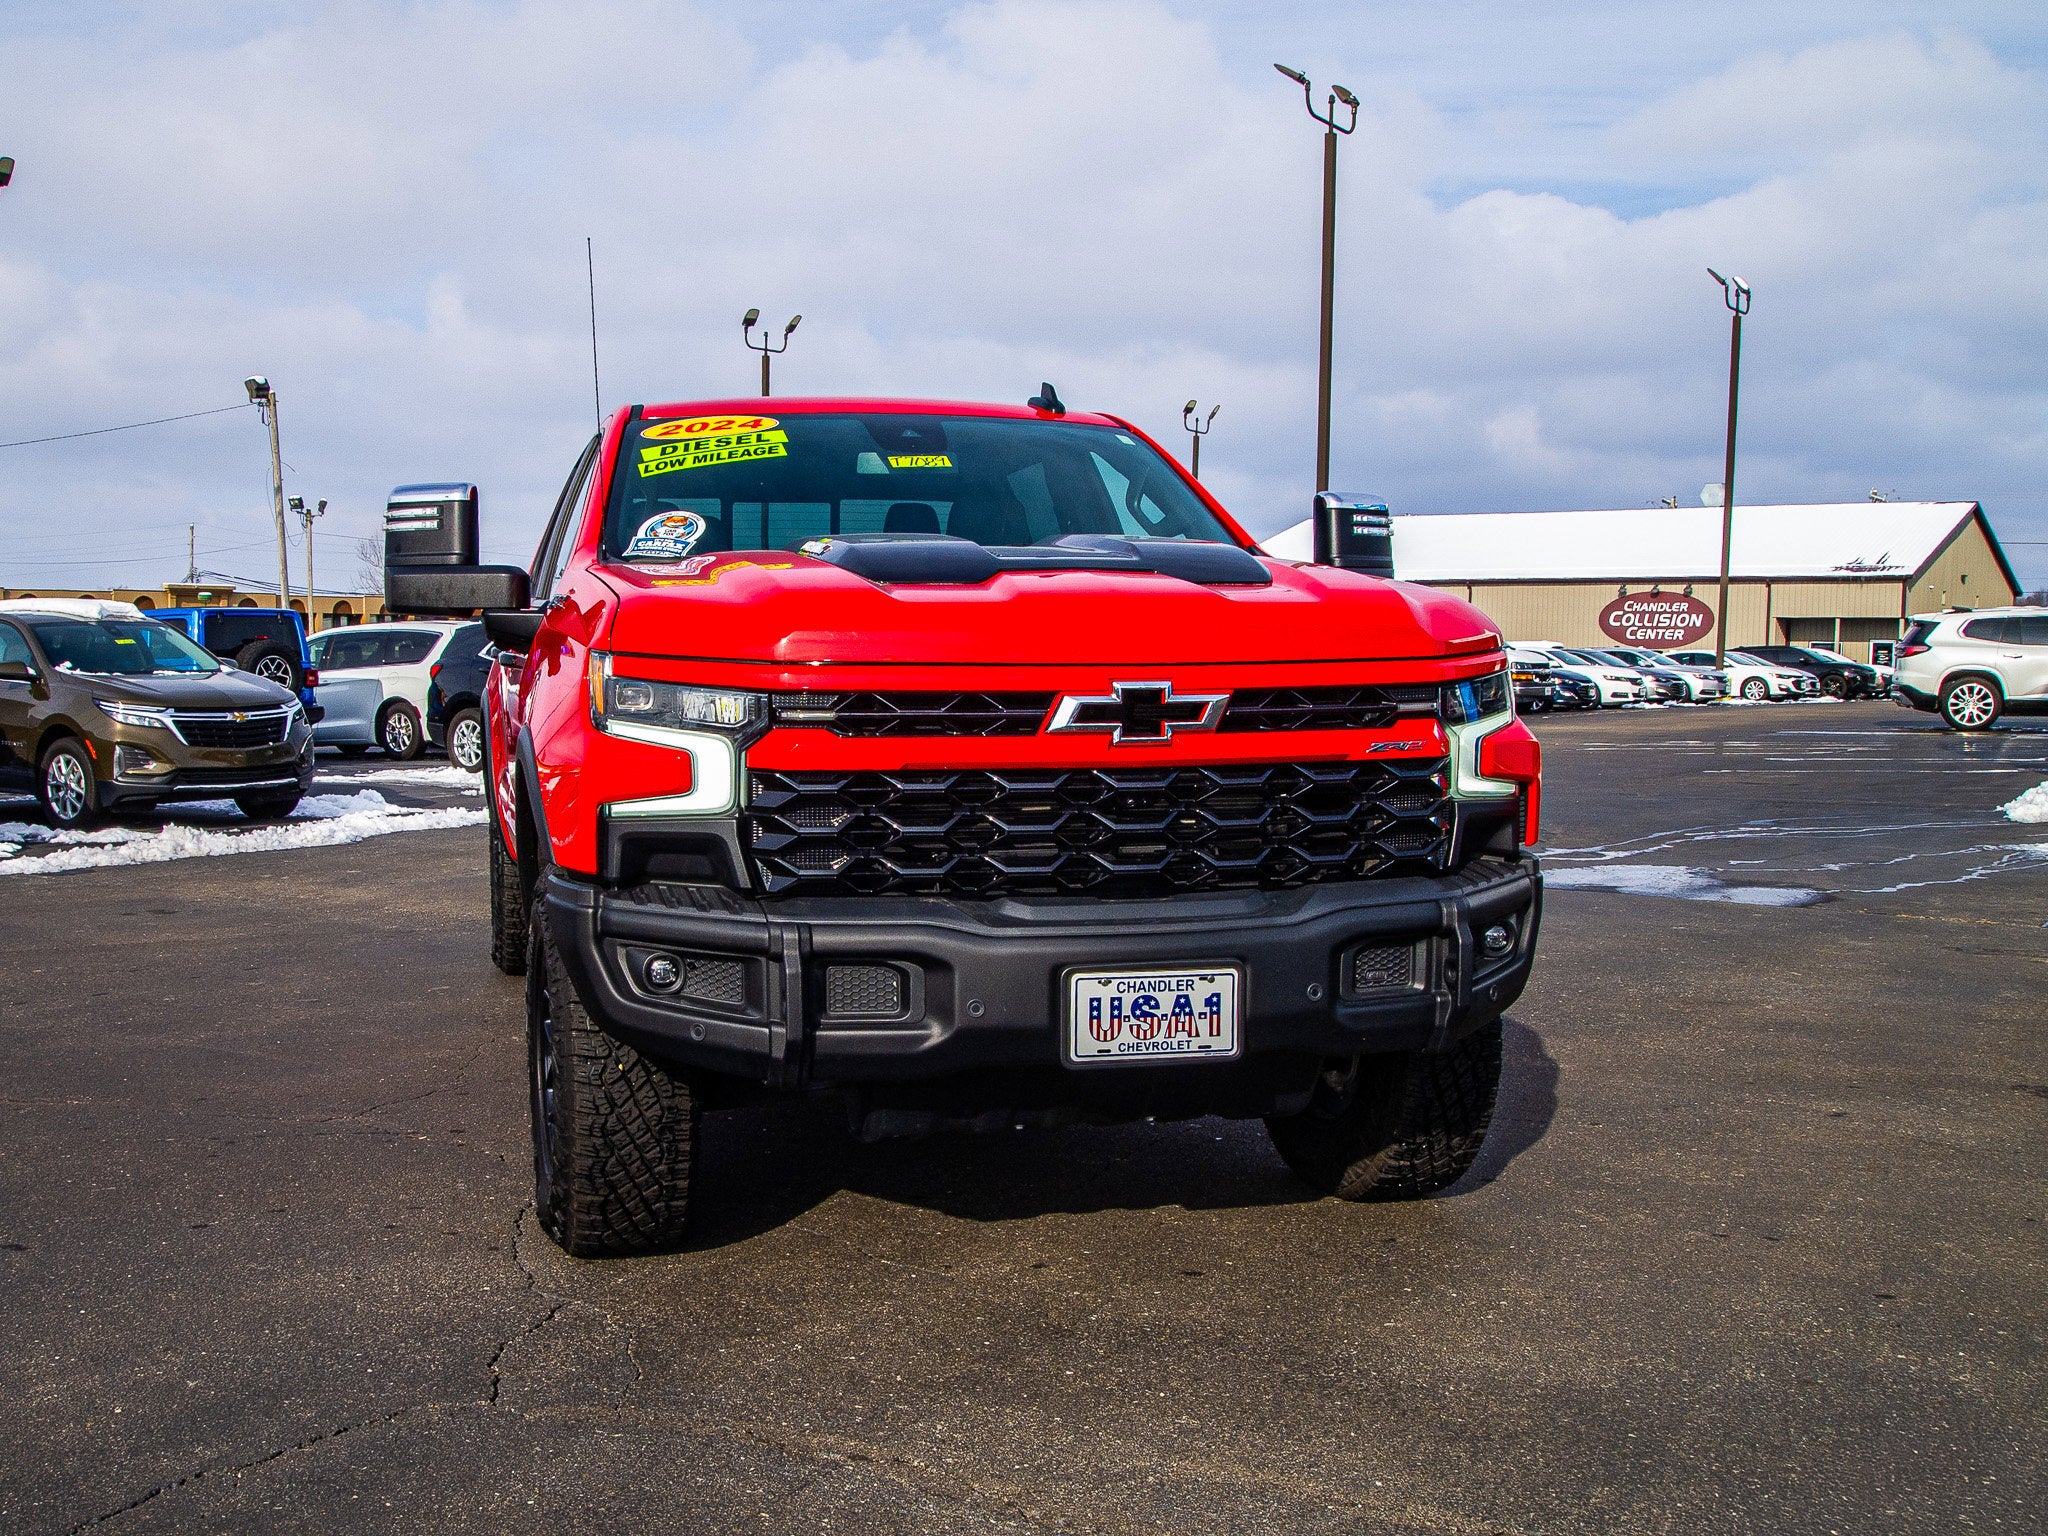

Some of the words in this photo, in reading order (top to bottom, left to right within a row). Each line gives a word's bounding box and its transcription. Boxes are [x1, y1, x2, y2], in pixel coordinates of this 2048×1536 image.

[656, 418, 763, 437] 2024
[660, 433, 771, 456] DIESEL
[643, 457, 686, 474] LOW
[692, 445, 780, 464] MILEAGE
[1624, 601, 1689, 612] CHANDLER
[1608, 611, 1704, 627] COLLISION
[1625, 627, 1684, 640] CENTER
[1116, 979, 1195, 994] CHANDLER
[1117, 1040, 1192, 1053] CHEVROLET
